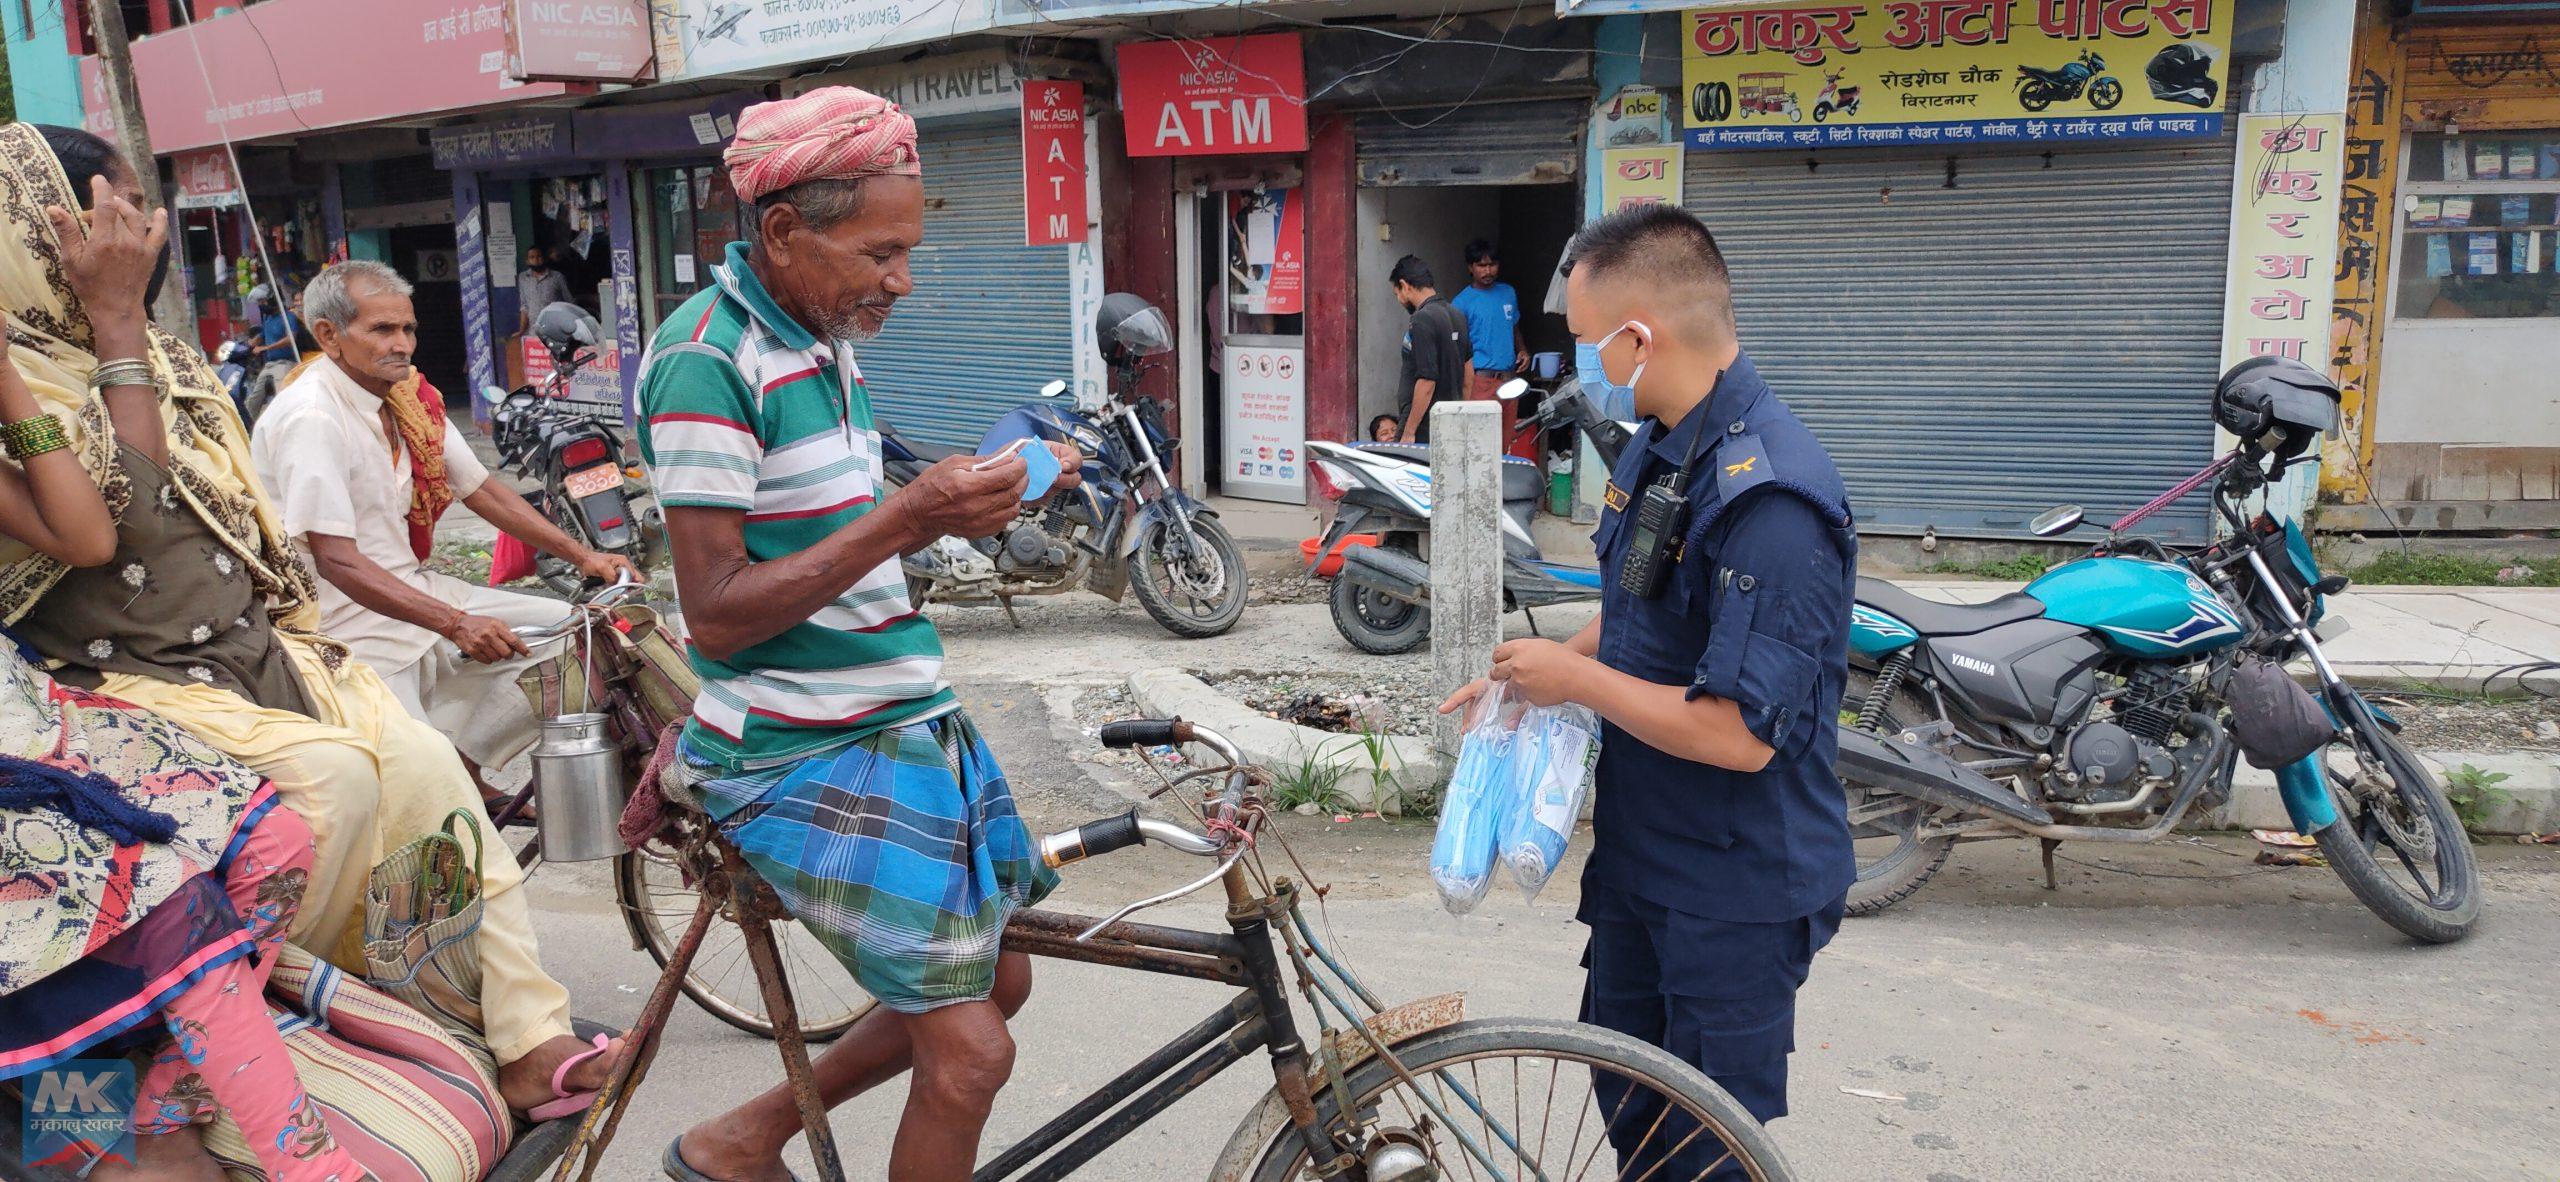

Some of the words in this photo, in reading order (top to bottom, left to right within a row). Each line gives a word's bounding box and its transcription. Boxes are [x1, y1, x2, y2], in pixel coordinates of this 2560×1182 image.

[531, 2, 573, 24] NIC
[580, 5, 638, 27] ASIA
[1694, 5, 1866, 66] ठाकुर
[1180, 73, 1201, 86] NIC
[1205, 71, 1239, 85] ASIA
[1959, 65, 2003, 85] चौक
[1626, 98, 1656, 115] nbc
[1901, 92, 1979, 109] विराटनगर
[1030, 109, 1049, 121] NIC
[1052, 109, 1079, 121] ASIA
[1154, 97, 1272, 148] ATM
[1829, 126, 1853, 142] सिटी
[2052, 123, 2062, 136] र
[2132, 117, 2152, 133] पनि
[2159, 118, 2196, 133] पाइन्छ
[1048, 138, 1069, 239] ATM
[1077, 242, 1099, 409] Airlin
[1262, 435, 1280, 443] Accept
[1240, 447, 1252, 455] VISA
[1952, 653, 1995, 676] YAMAHA
